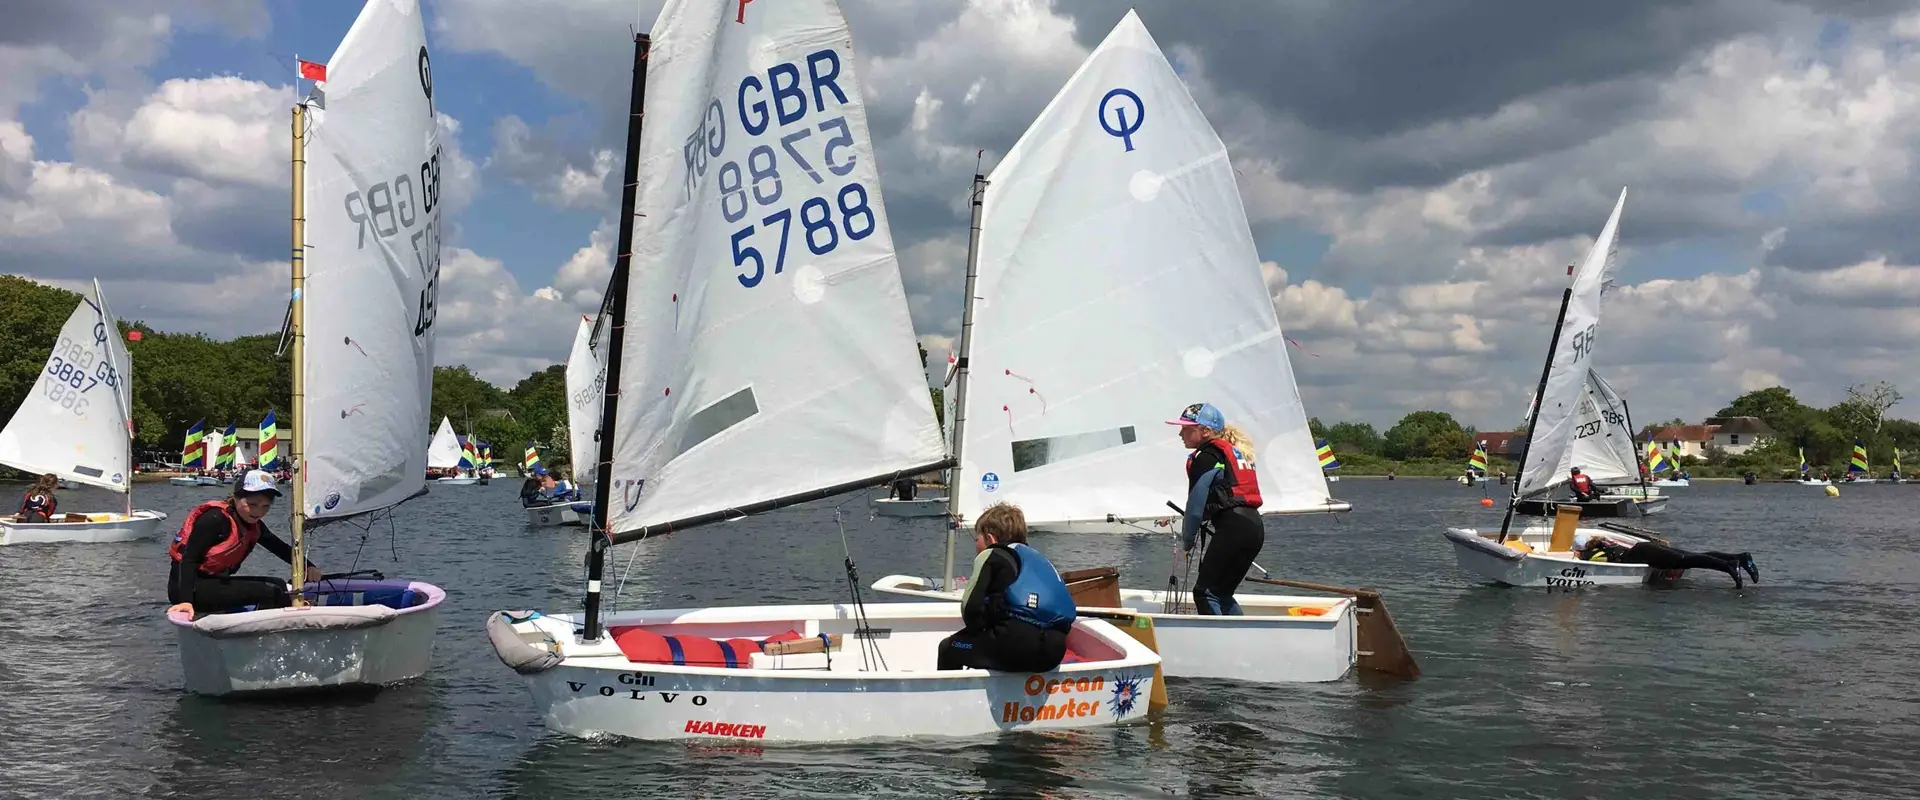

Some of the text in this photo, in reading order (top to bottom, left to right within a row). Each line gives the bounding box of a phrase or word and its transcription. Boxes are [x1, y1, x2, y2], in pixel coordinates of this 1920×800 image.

[738, 49, 849, 136] GBR
[421, 145, 440, 214] GB
[731, 183, 875, 288] 5788
[48, 357, 98, 393] 3887
[1574, 420, 1601, 439] 237
[1561, 567, 1586, 578] Gill
[618, 671, 655, 687] Gill
[1024, 675, 1105, 697] Ocean
[566, 681, 708, 707] VOLVO
[1002, 699, 1101, 723] Hamster
[684, 719, 767, 739] HARKEN
